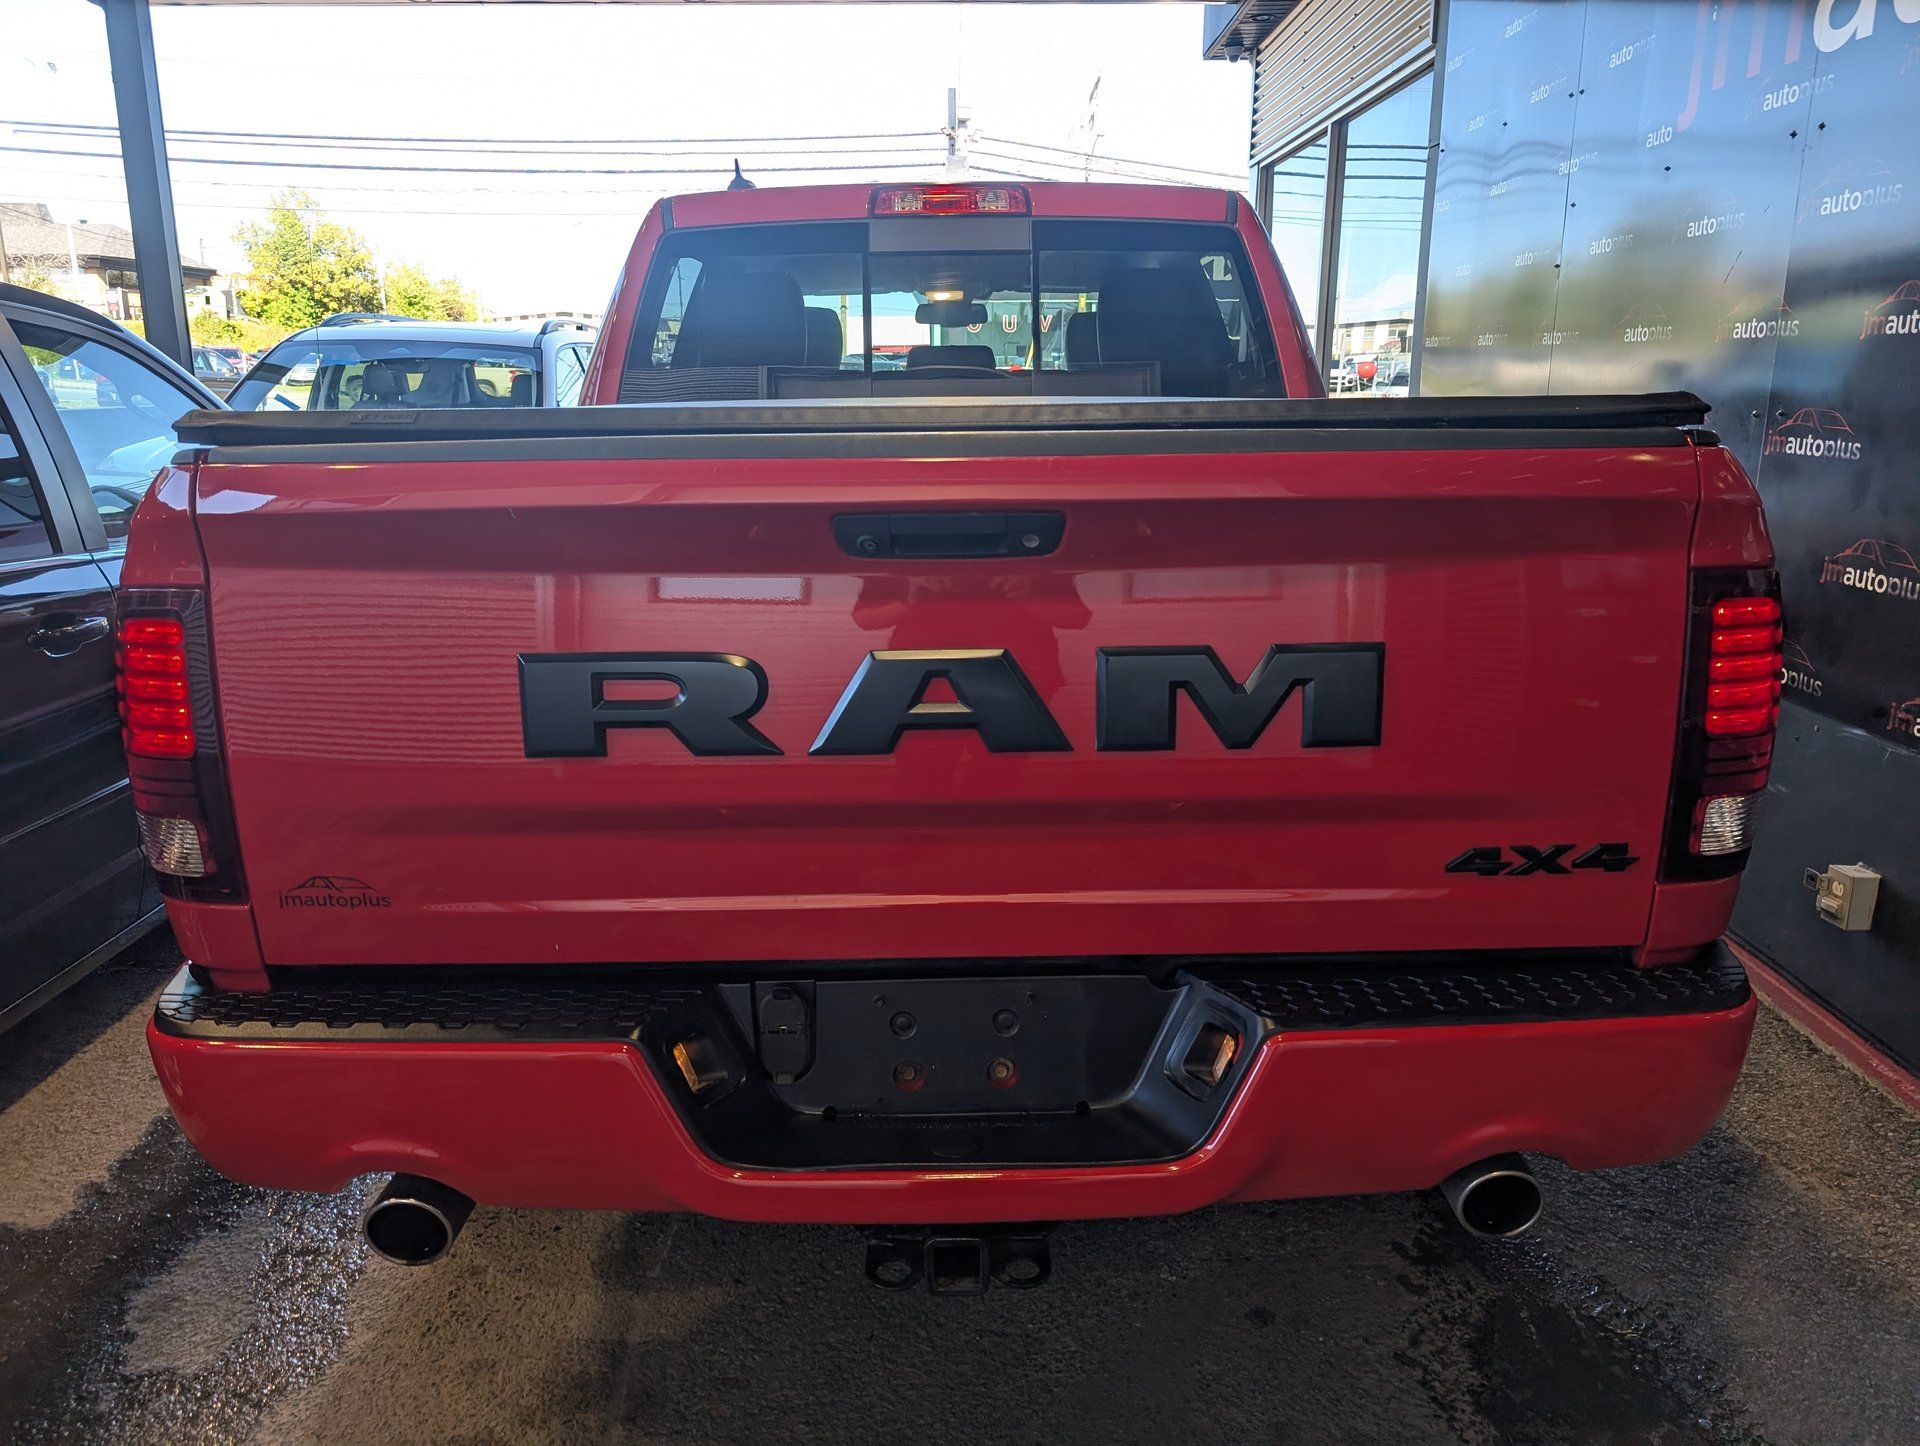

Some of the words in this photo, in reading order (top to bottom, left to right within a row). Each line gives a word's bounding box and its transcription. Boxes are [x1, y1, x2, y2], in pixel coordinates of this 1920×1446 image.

[1764, 429, 1862, 460] jmautoplus
[516, 641, 1386, 758] RAM
[1444, 842, 1641, 877] 4X4
[278, 891, 392, 910] jmautoplus
